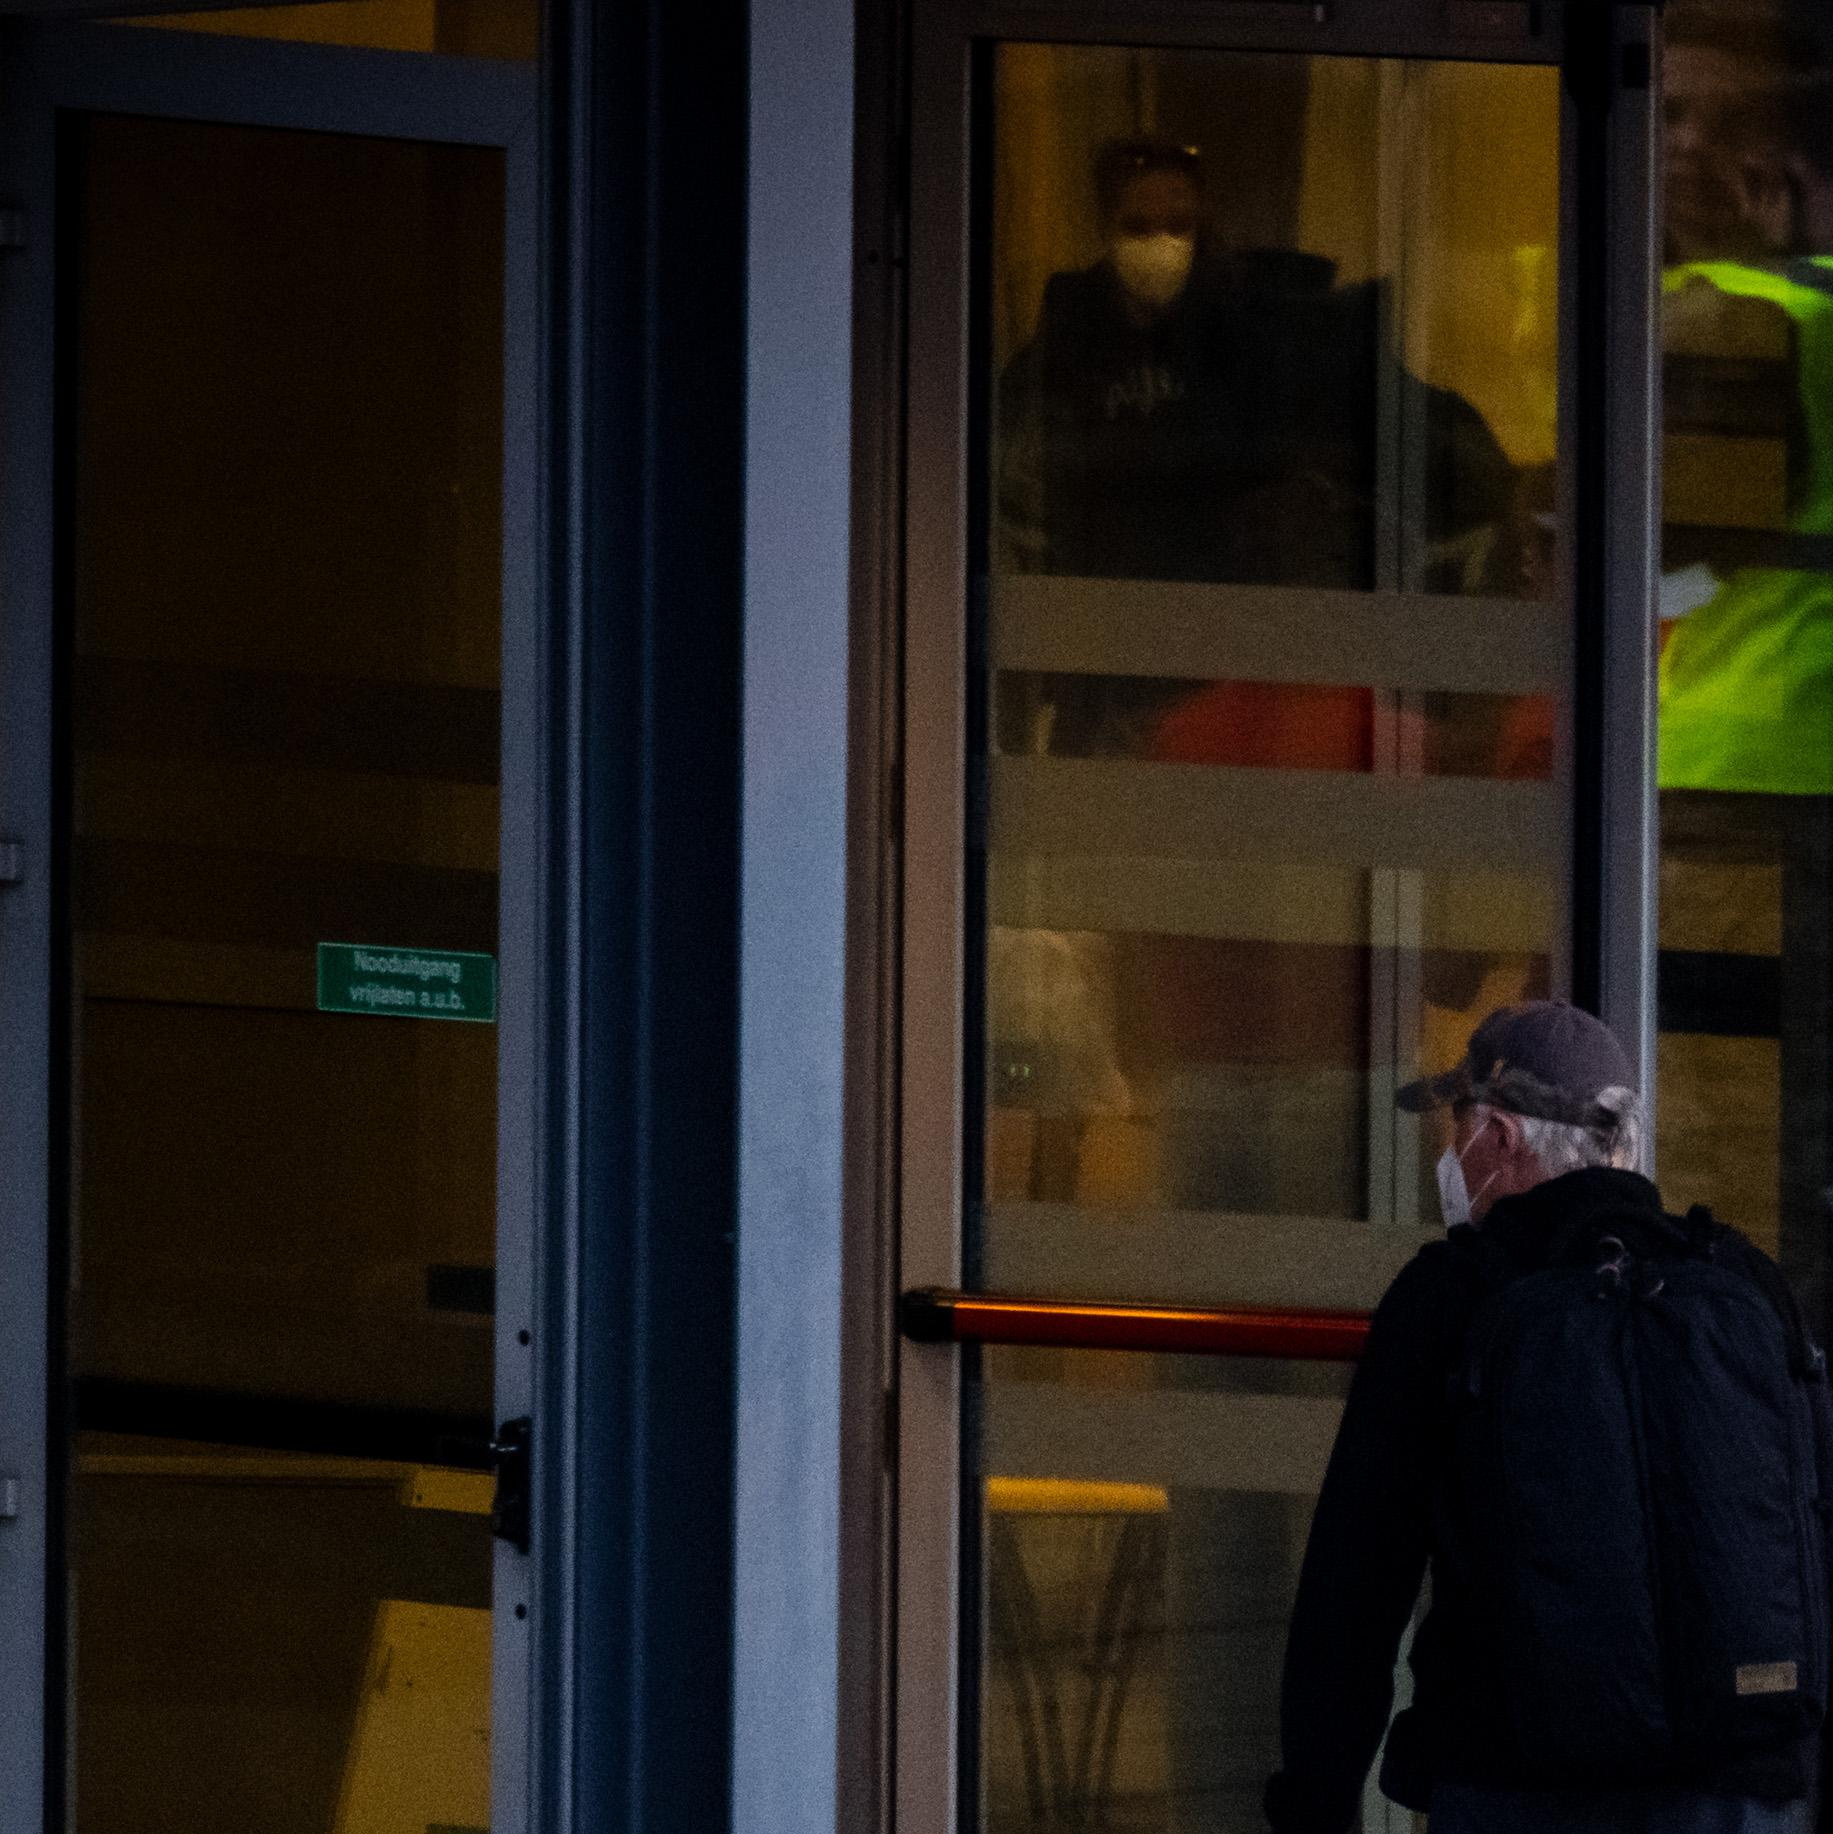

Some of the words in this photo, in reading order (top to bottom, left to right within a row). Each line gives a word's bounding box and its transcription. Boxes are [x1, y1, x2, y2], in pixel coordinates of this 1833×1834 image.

[353, 950, 461, 984] Nooduitgang
[350, 982, 415, 1007] vrijlaten
[420, 989, 466, 1010] a.u.b.
